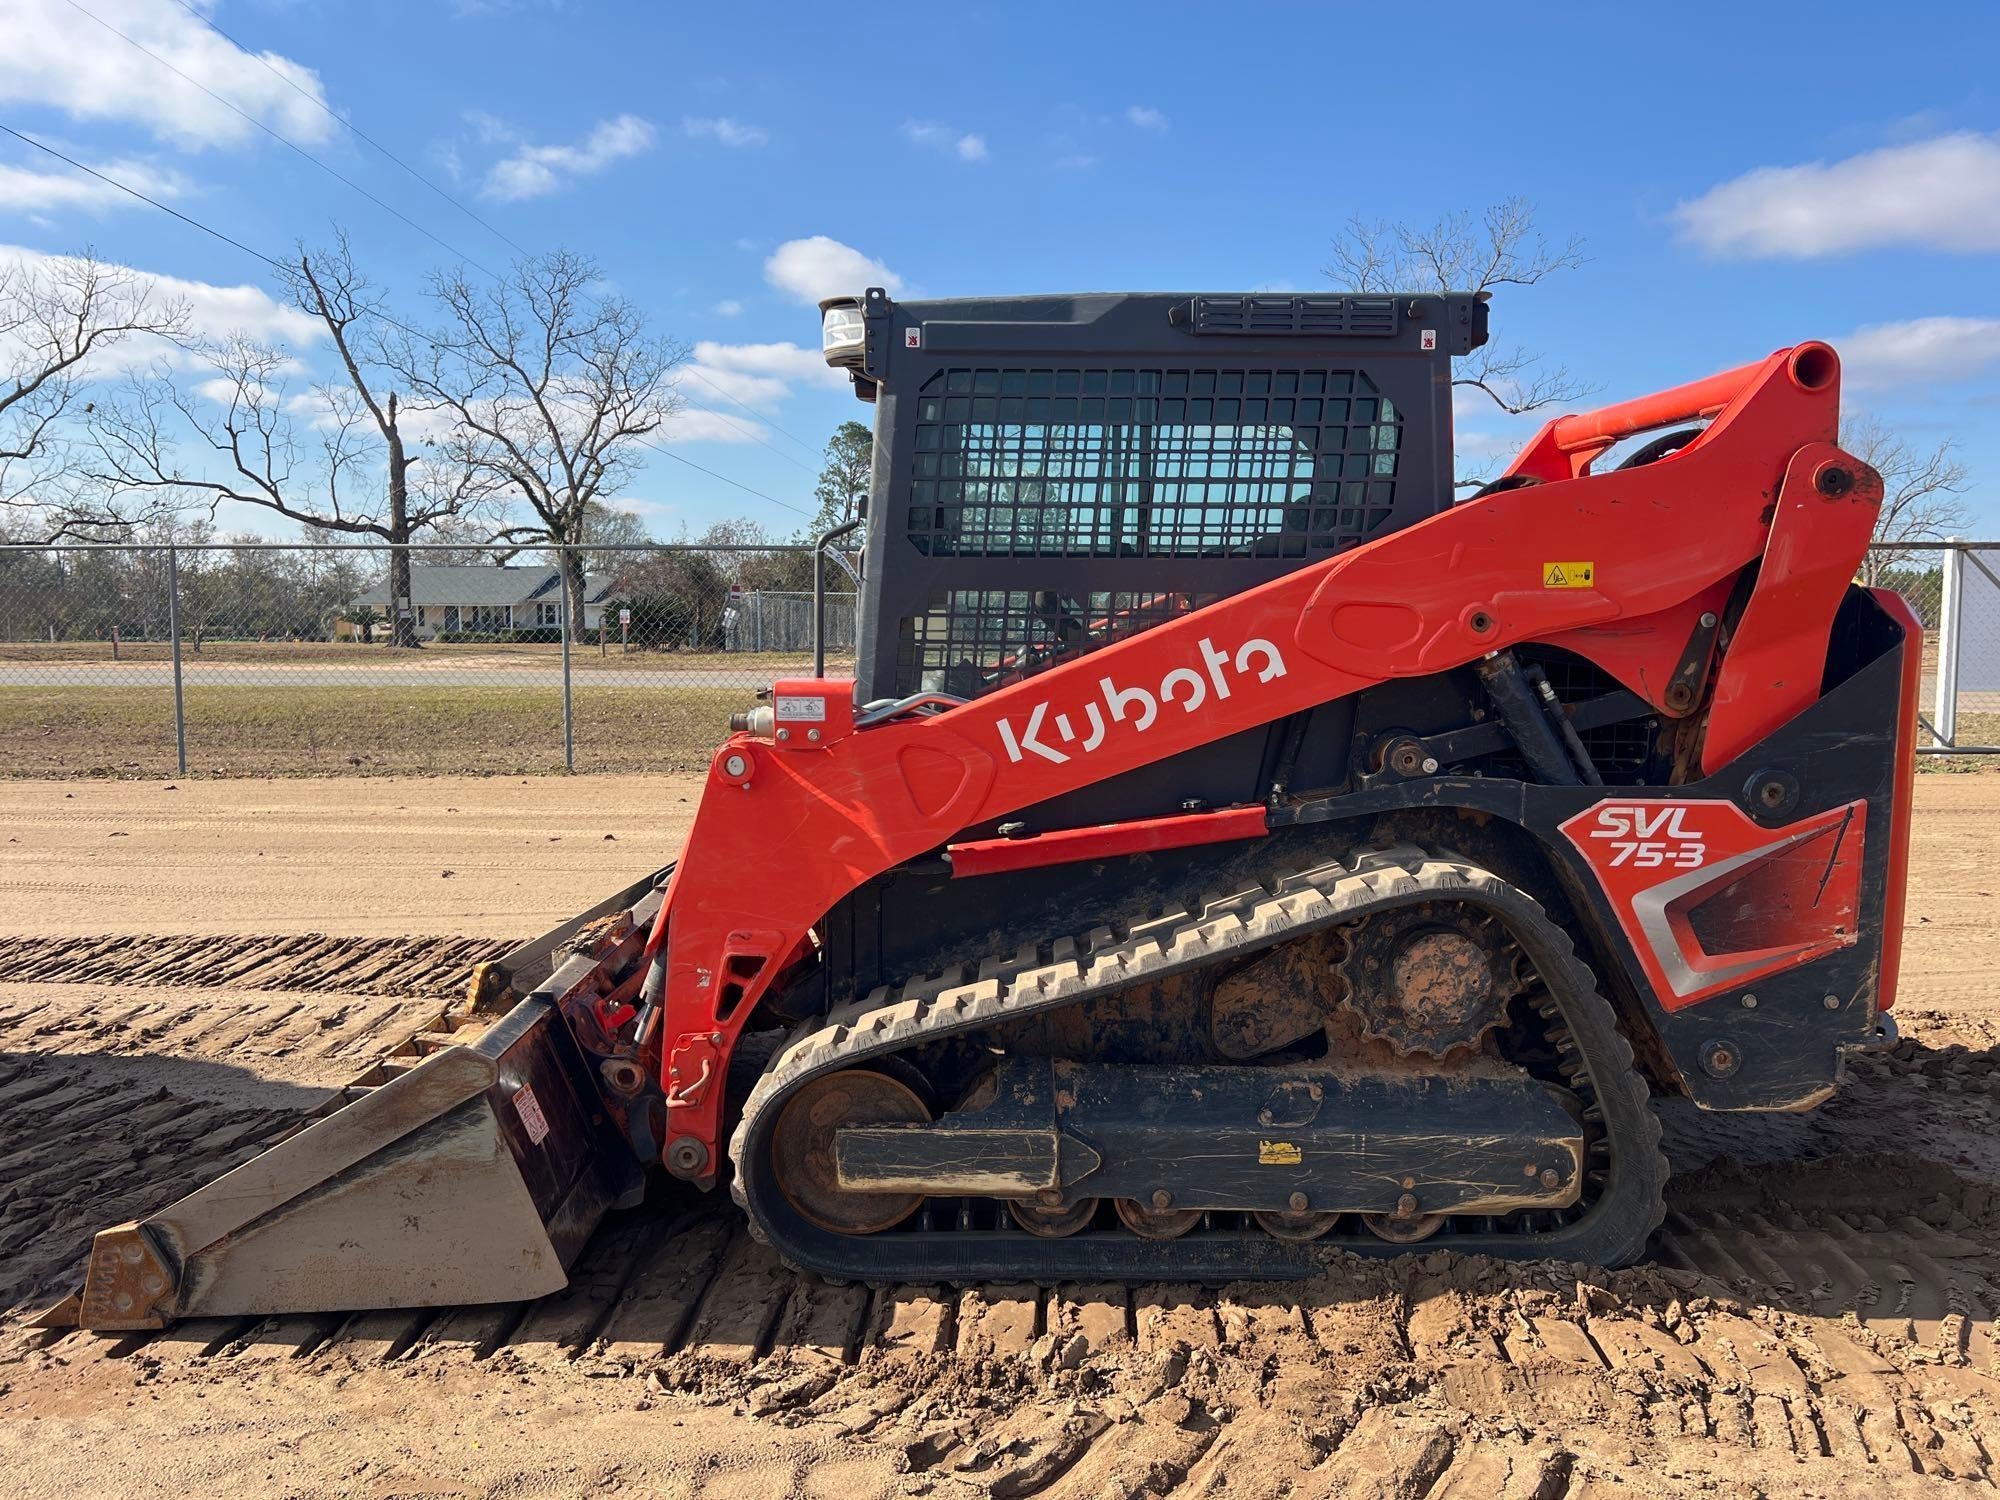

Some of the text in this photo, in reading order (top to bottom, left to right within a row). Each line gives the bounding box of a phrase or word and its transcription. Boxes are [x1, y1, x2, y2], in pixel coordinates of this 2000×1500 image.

[996, 637, 1287, 764] Kubota
[1589, 807, 1703, 838] SVL
[1608, 842, 1706, 868] 75-3
